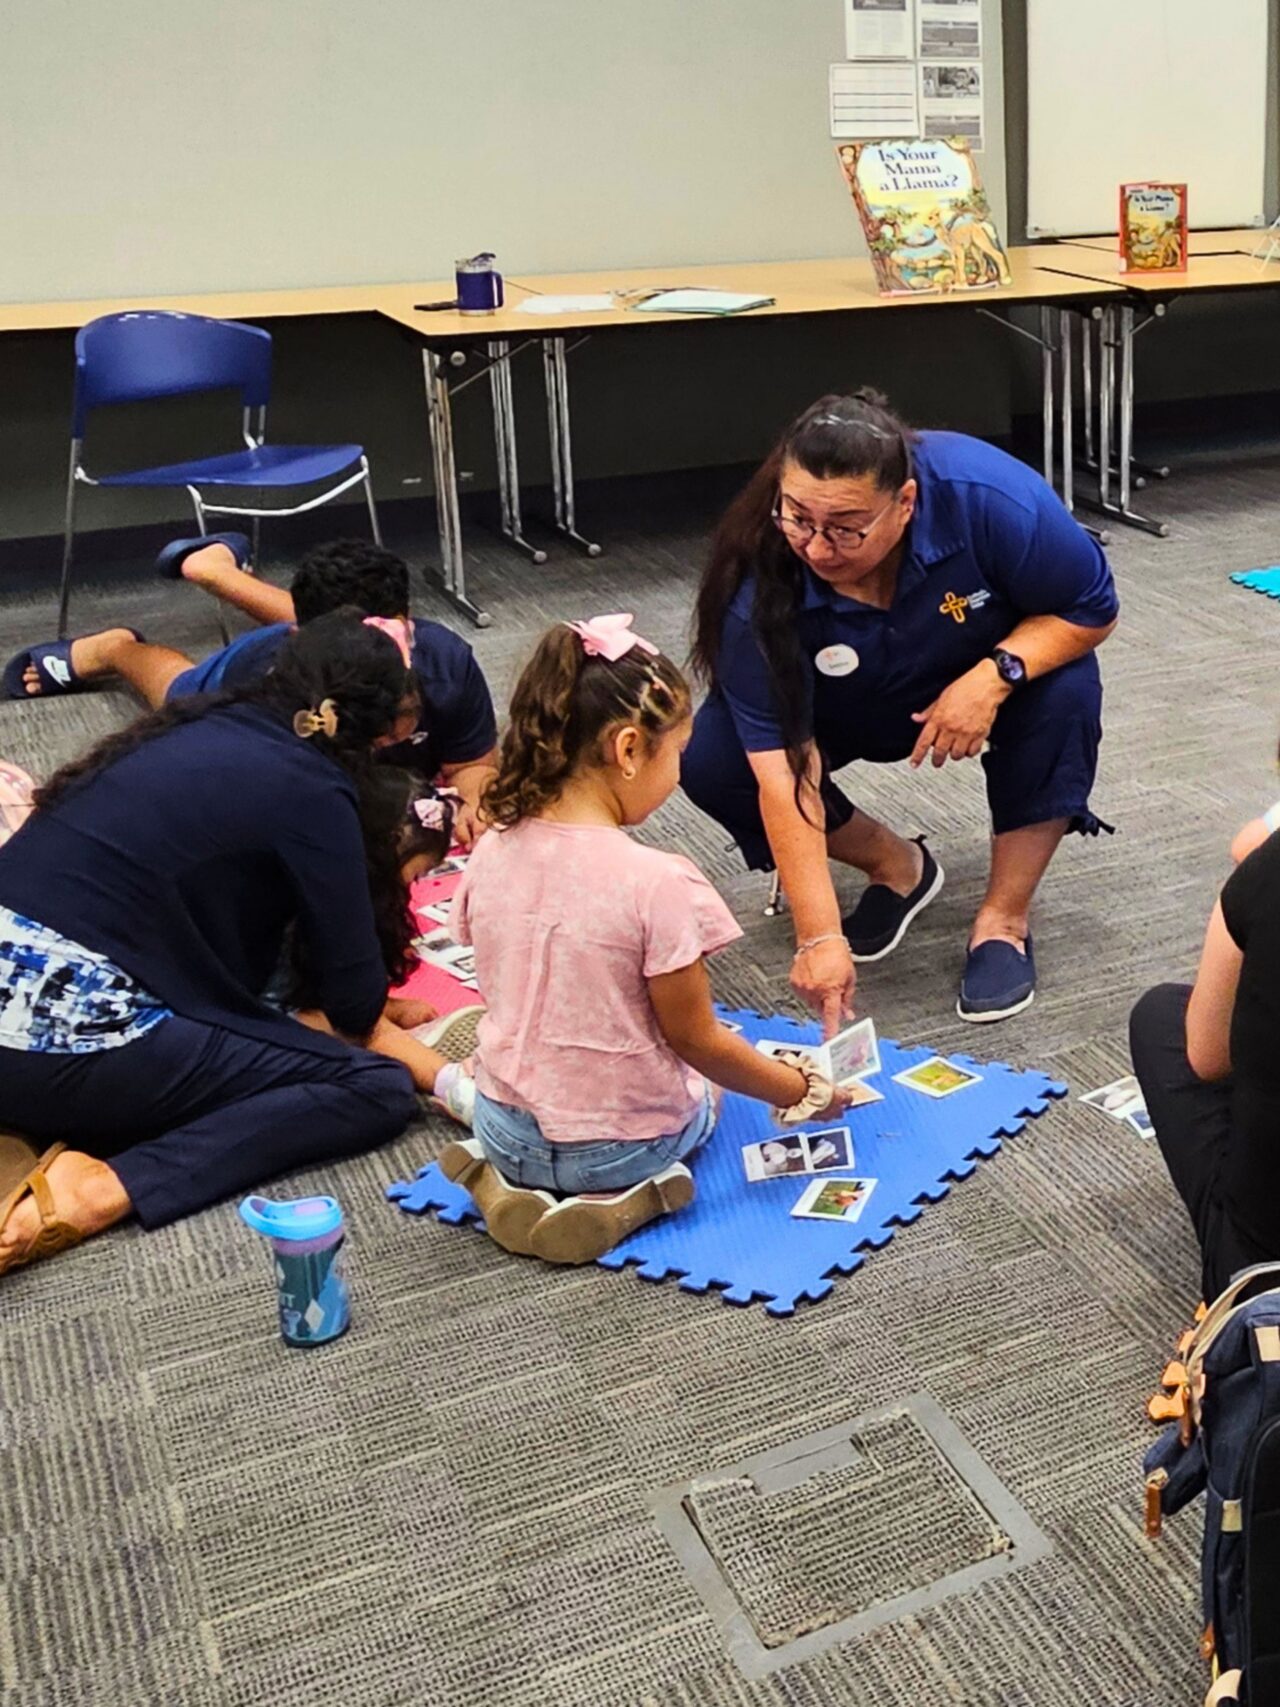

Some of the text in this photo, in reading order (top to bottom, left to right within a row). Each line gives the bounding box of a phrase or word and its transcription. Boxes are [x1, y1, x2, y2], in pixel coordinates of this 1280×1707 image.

[878, 147, 938, 162] Is Your
[884, 162, 942, 176] Mama
[880, 174, 959, 191] a Llama?
